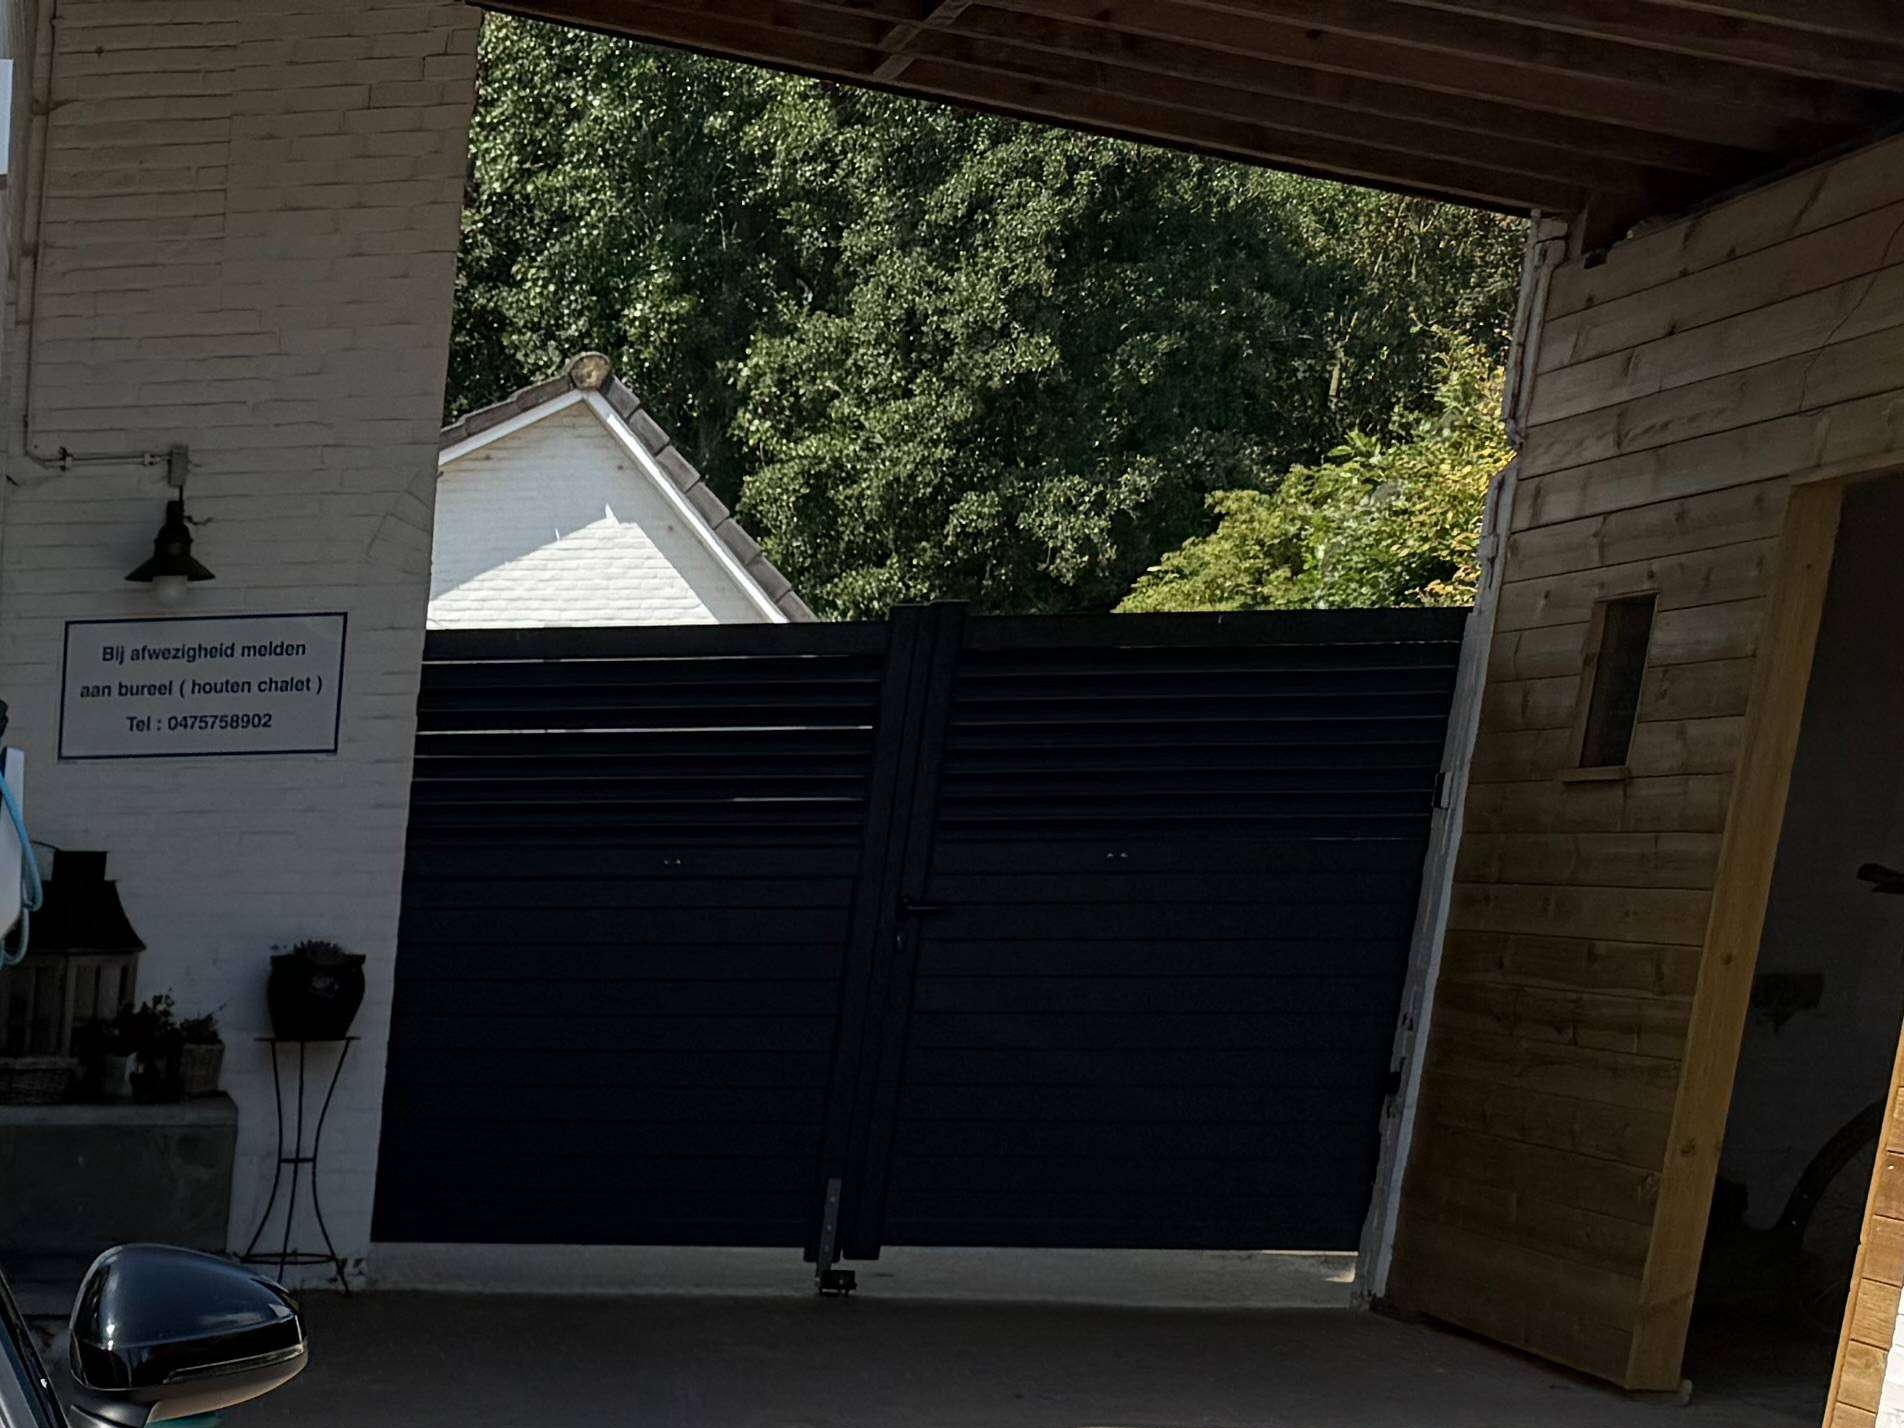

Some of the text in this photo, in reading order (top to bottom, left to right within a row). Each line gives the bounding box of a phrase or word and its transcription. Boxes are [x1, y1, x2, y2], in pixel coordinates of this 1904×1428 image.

[102, 641, 306, 665] Bij afwezigheid melden
[80, 683, 111, 698] aan
[118, 680, 173, 697] bureel
[192, 678, 252, 695] houten
[258, 676, 311, 693] chalet
[126, 716, 151, 732] Tel
[168, 713, 272, 731] 0475758902
